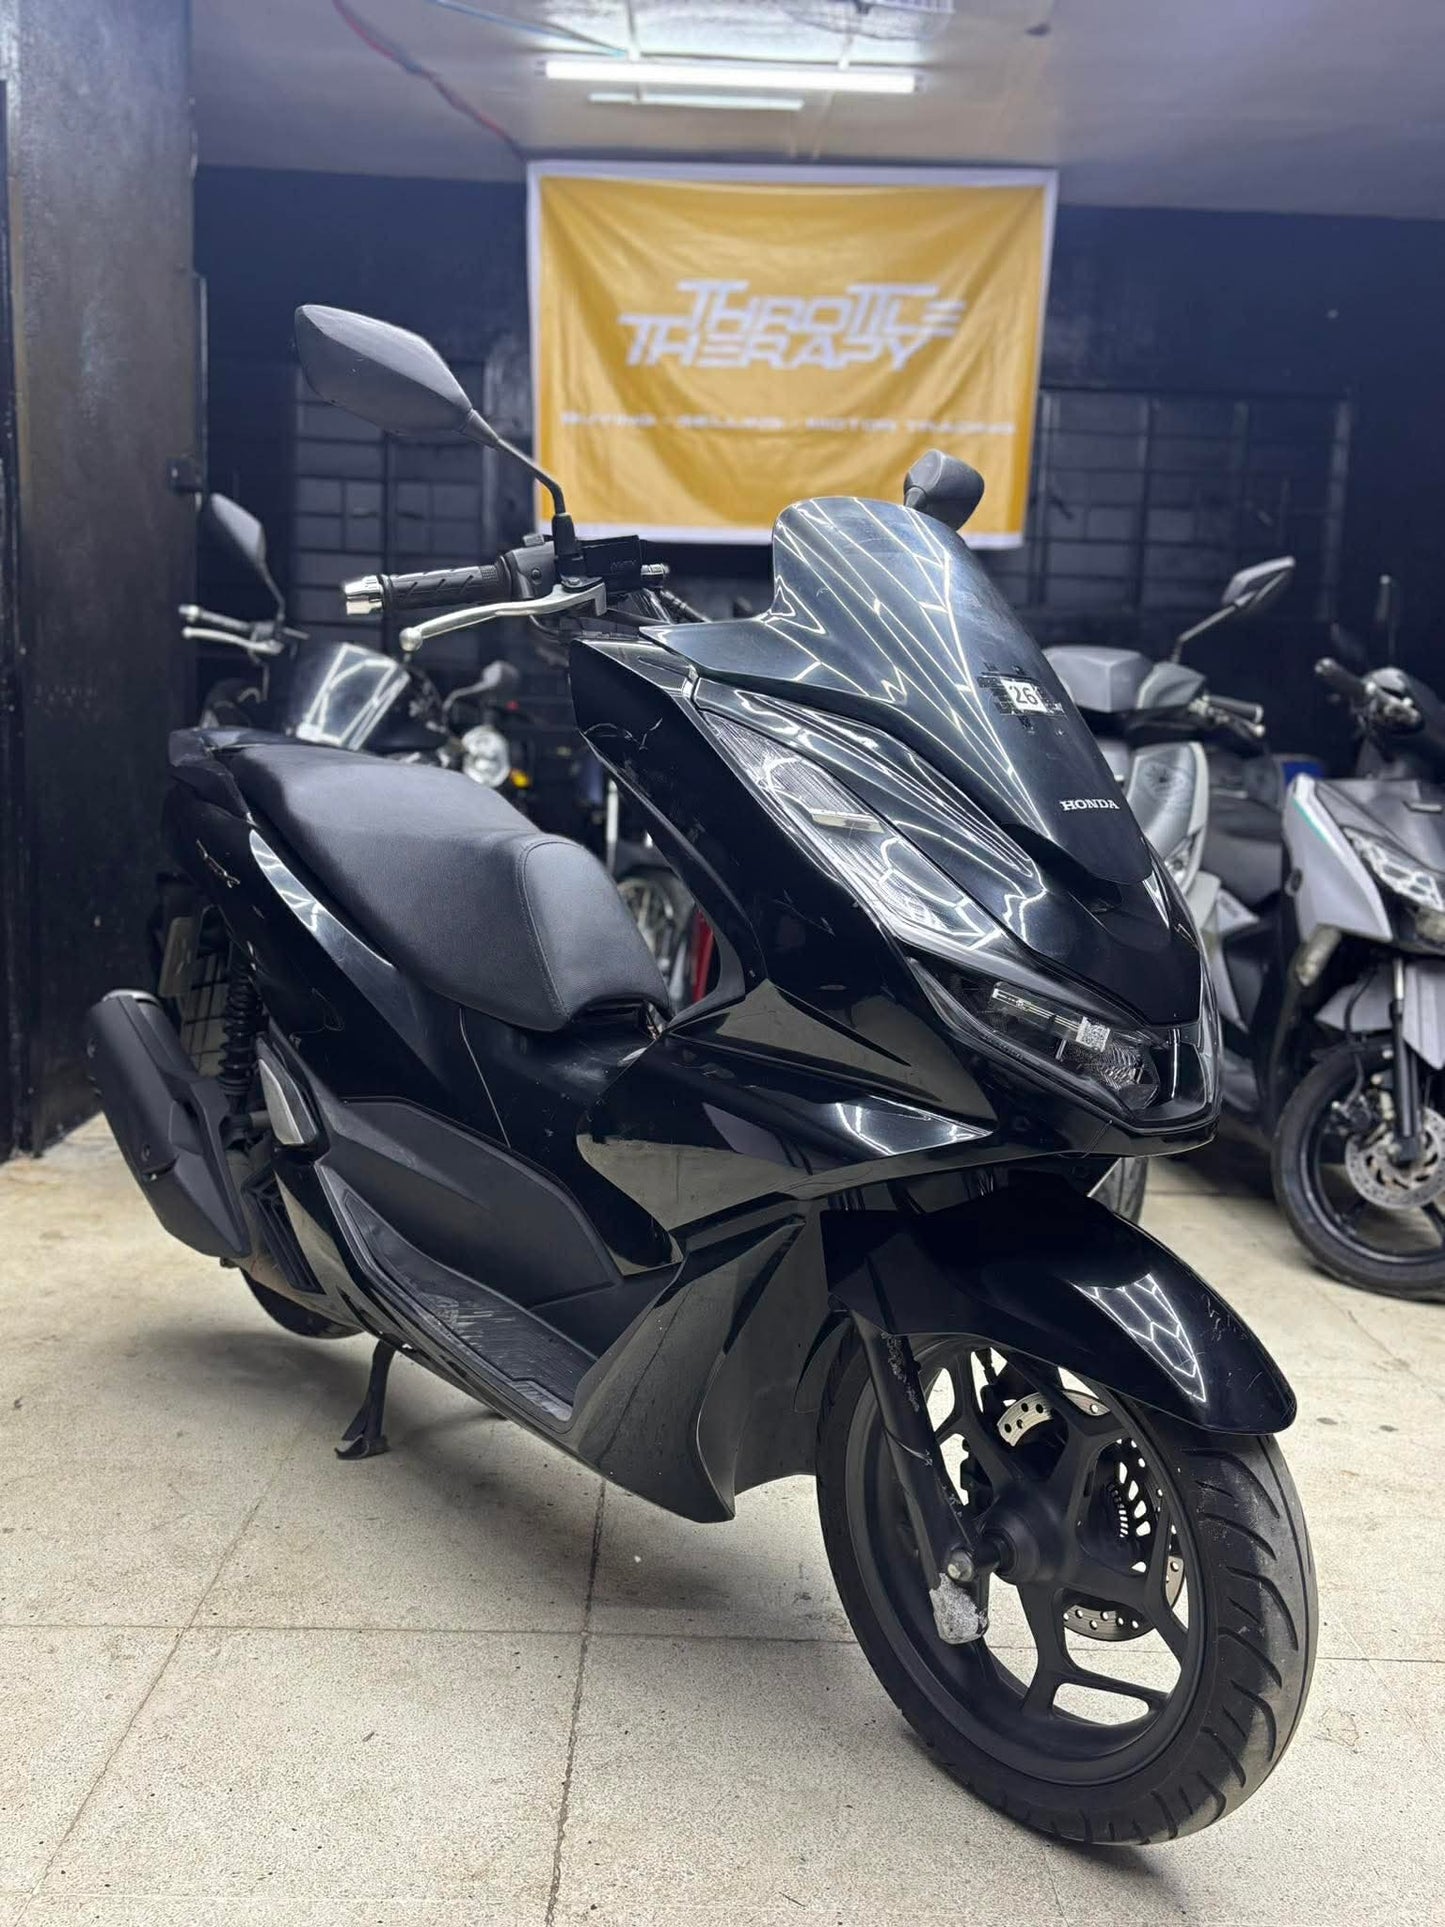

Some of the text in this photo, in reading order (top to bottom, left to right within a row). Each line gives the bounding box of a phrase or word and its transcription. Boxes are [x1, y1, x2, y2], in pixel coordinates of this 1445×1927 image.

[677, 279, 965, 337] THROTTLE
[618, 313, 940, 371] THERAPY
[1008, 685, 1039, 705] 26
[1059, 798, 1120, 812] HONDA
